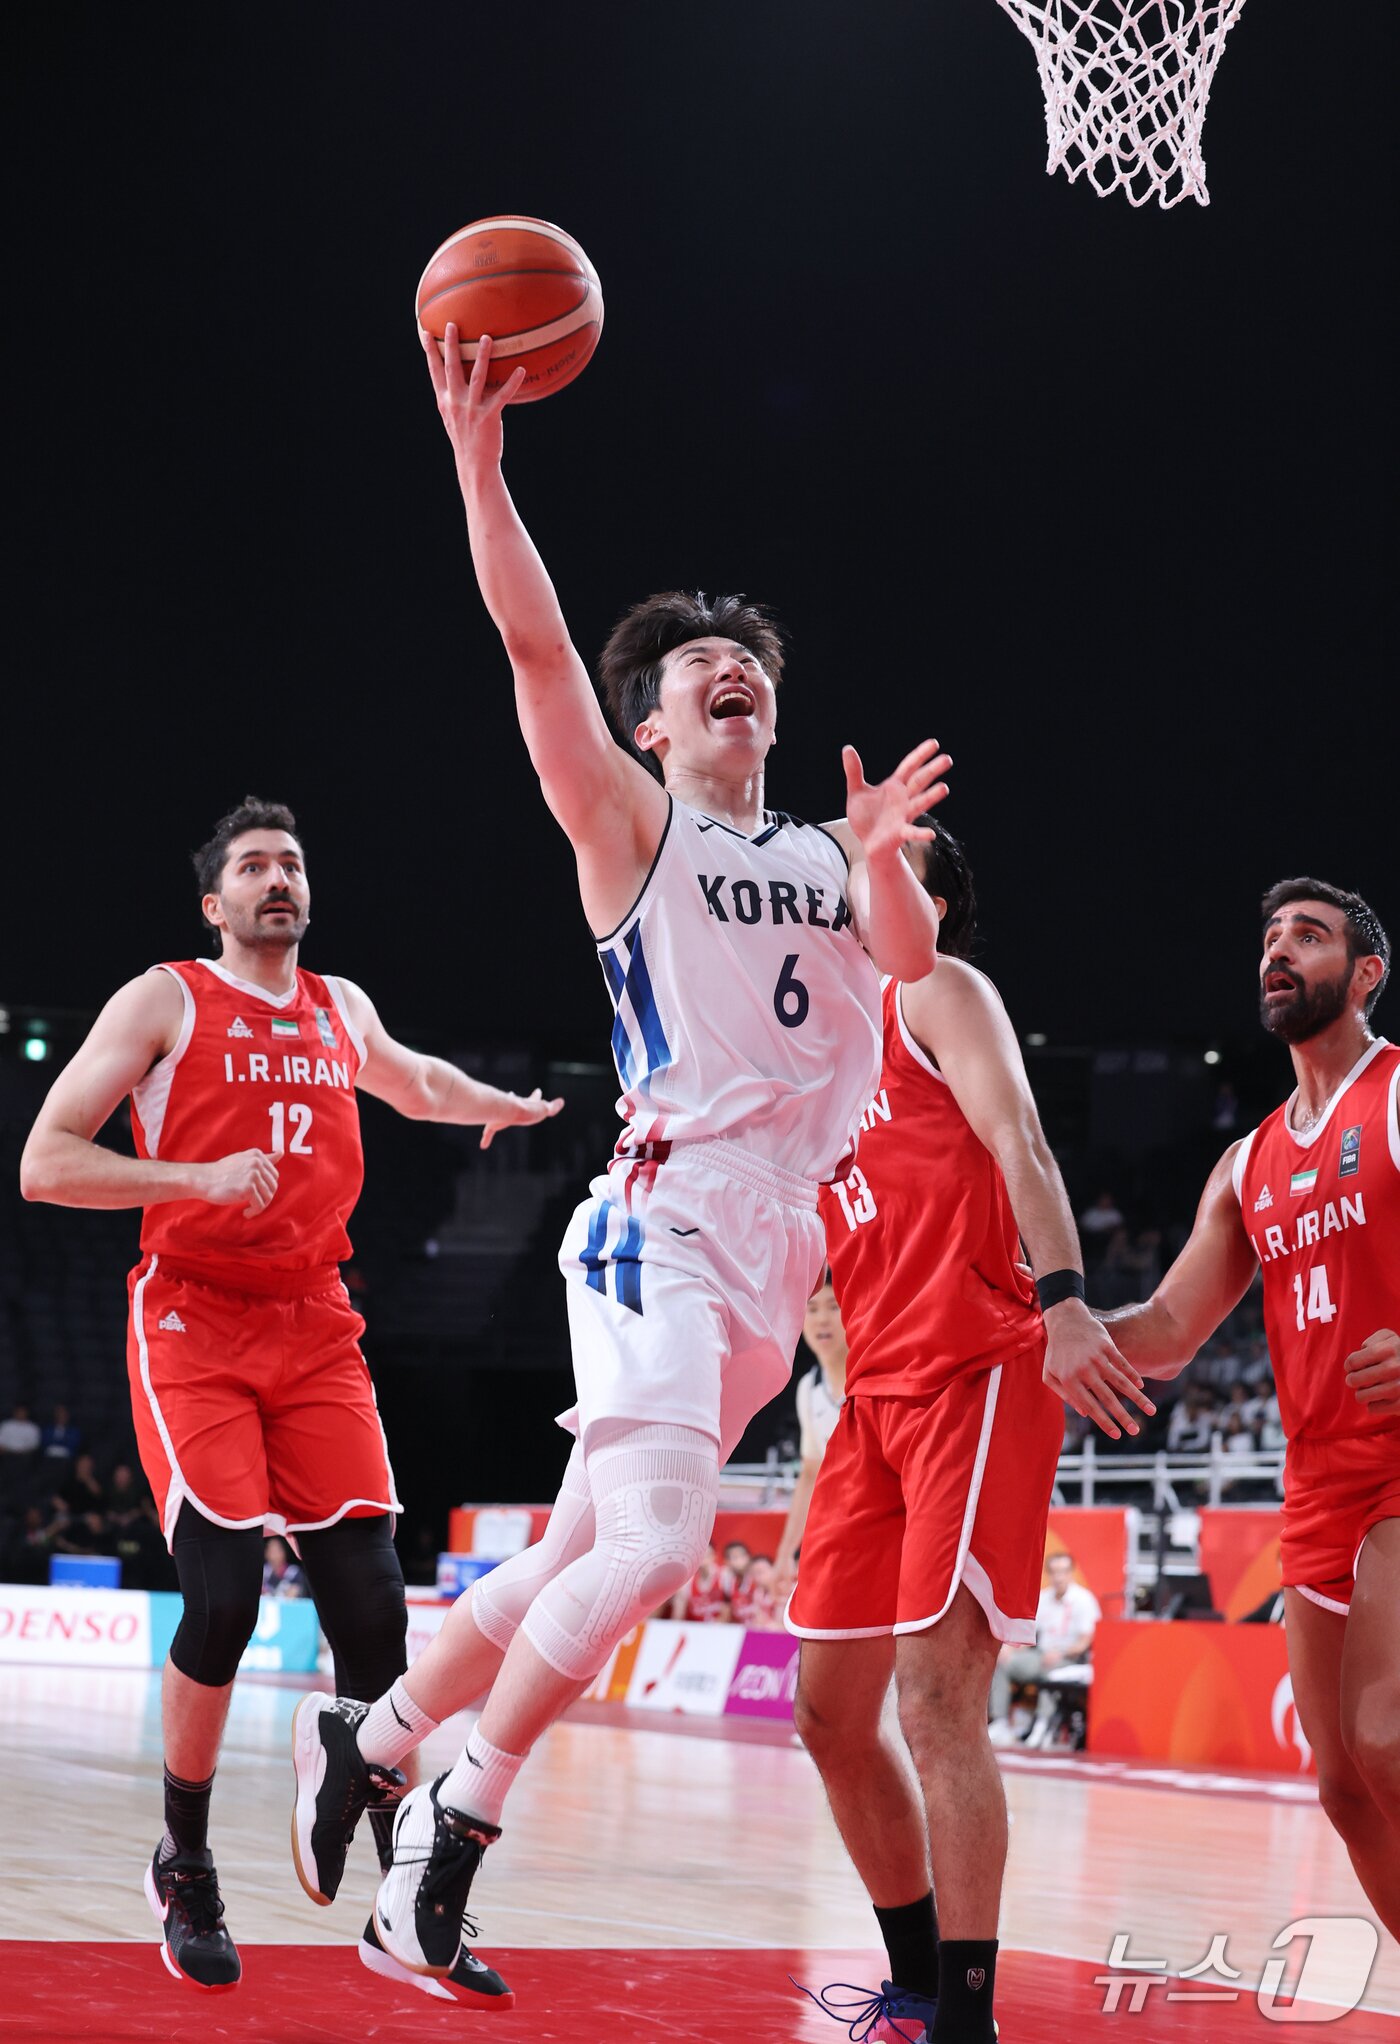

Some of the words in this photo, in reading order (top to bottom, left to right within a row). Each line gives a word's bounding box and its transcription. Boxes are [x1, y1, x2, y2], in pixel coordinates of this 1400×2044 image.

[697, 874, 851, 931] KOREA
[773, 954, 809, 1028] 6
[226, 1027, 255, 1039] PEAK
[224, 1053, 350, 1090] I.R.IRAN
[268, 1101, 313, 1154] 12
[1342, 1153, 1357, 1166] FIBA
[829, 1164, 878, 1232] 13
[1253, 1194, 1275, 1213] PEAK
[1293, 1264, 1338, 1332] 14
[158, 1319, 187, 1333] PEAK
